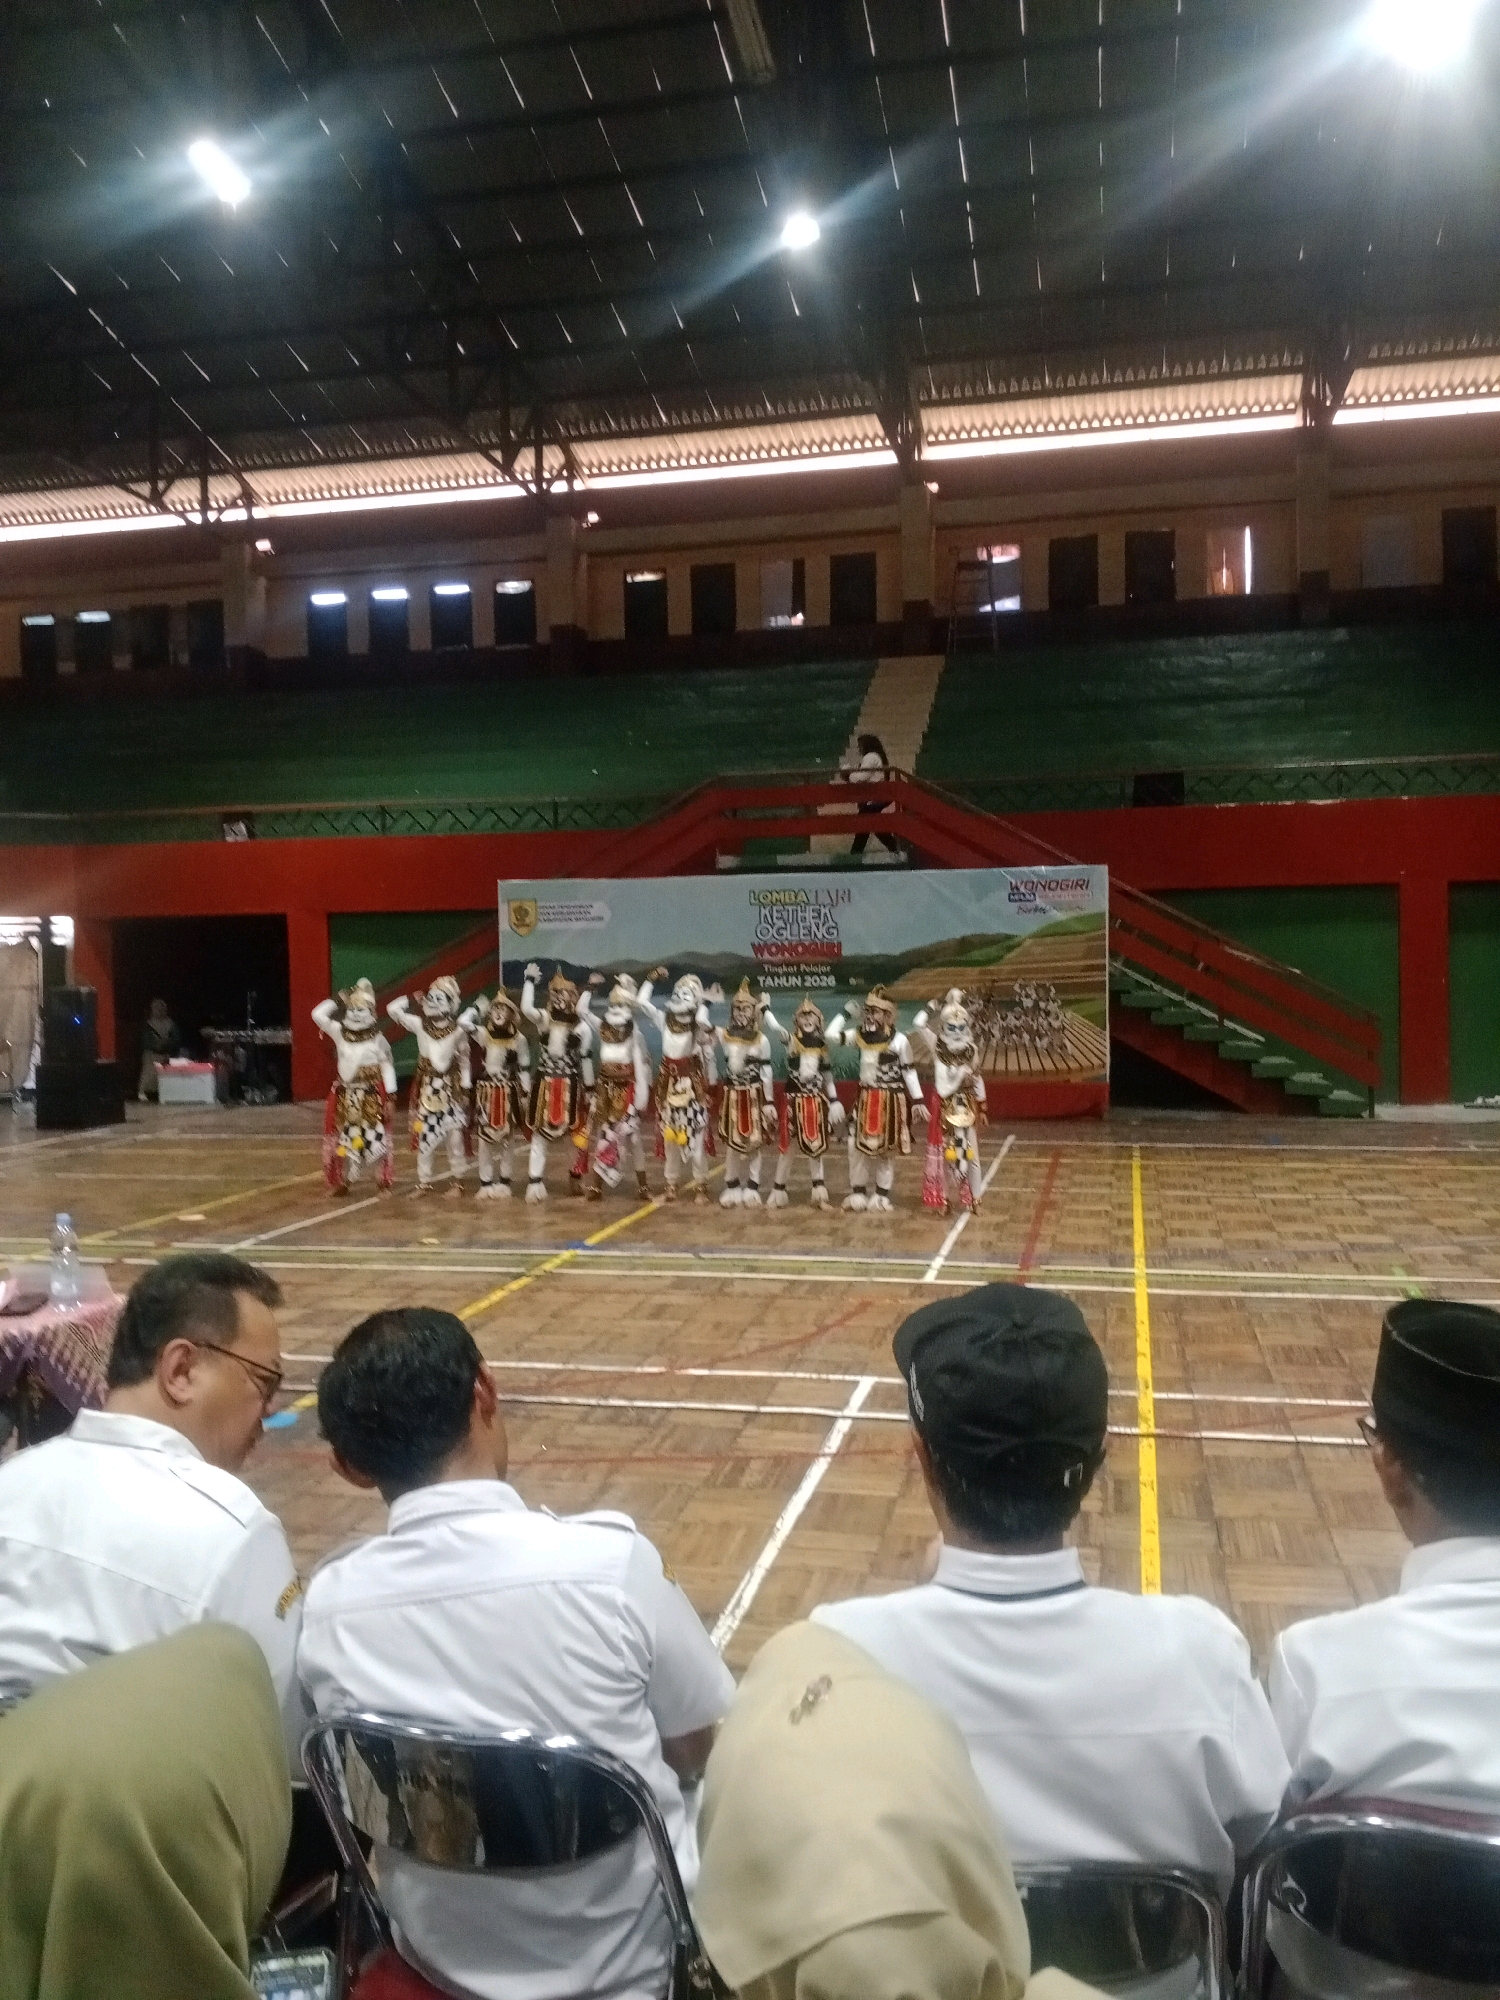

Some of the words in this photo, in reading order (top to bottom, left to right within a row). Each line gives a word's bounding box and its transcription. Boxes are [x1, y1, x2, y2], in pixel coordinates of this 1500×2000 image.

[1010, 878, 1089, 891] WONOGIRI
[749, 888, 809, 906] LOMBA
[809, 888, 851, 906] TARI
[760, 904, 838, 925] KETHEK
[755, 922, 839, 941] OGLENG
[751, 941, 842, 959] WONOGIRI
[763, 963, 797, 974] Tingkat
[800, 963, 831, 974] Pelajar
[757, 975, 802, 988] TAHUN
